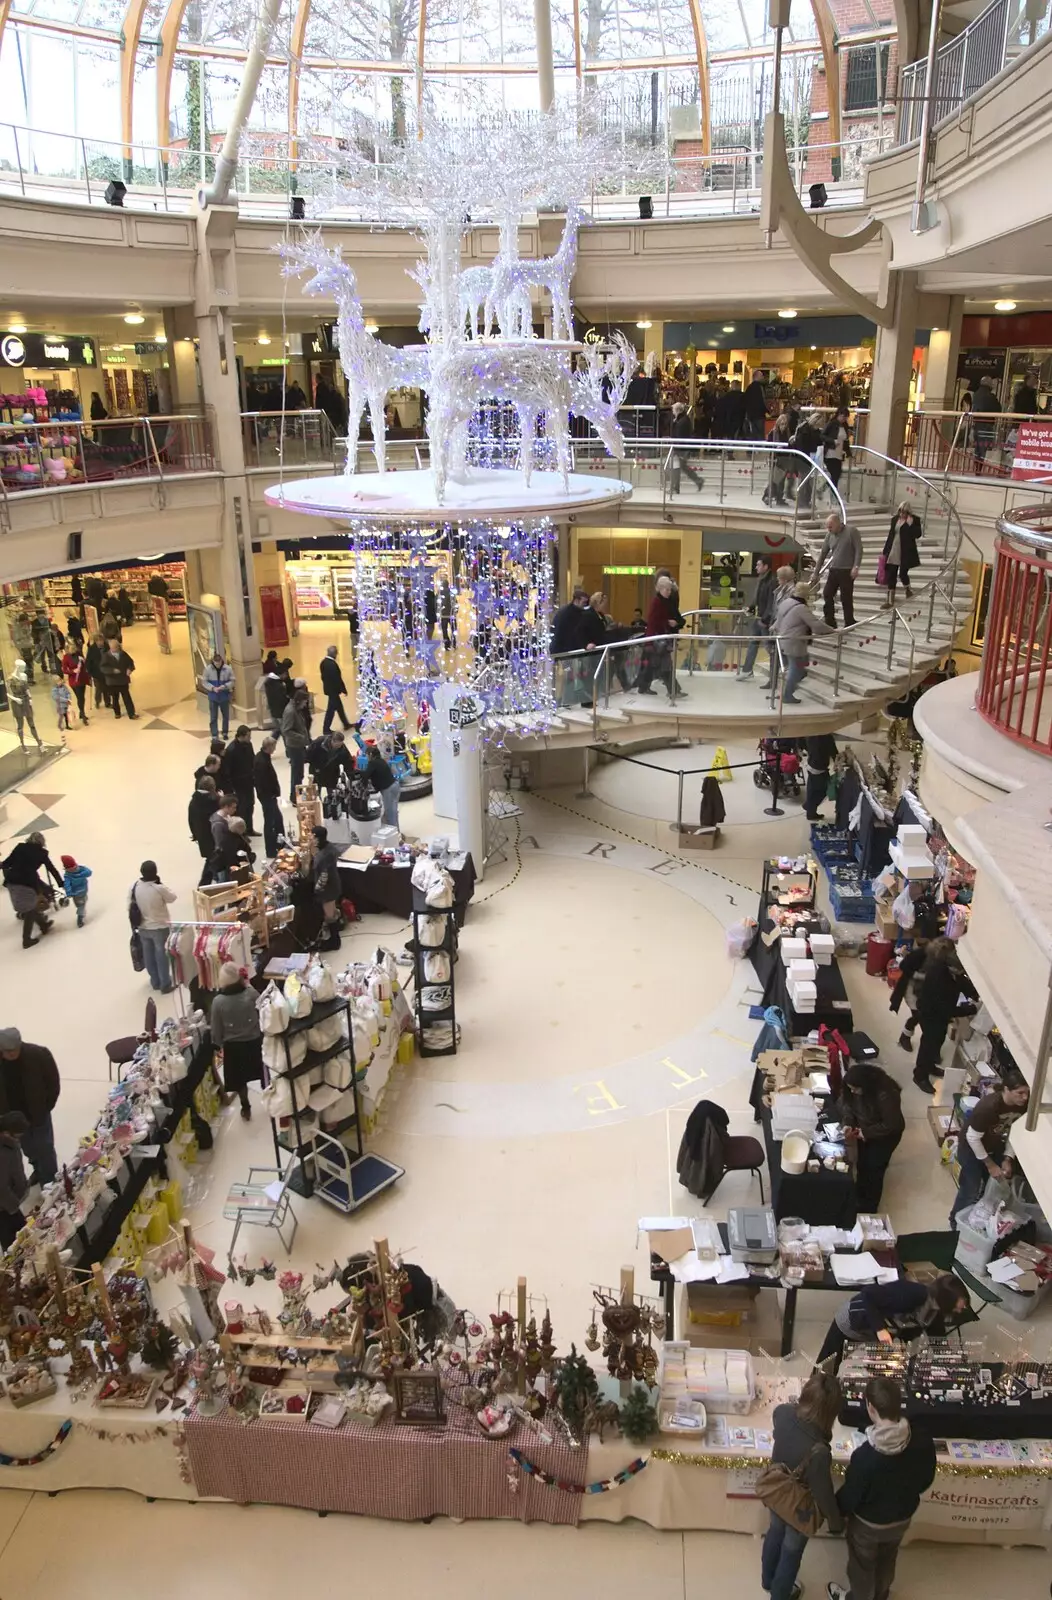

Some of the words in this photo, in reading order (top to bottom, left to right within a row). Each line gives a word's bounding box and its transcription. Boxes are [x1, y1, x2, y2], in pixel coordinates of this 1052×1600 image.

[971, 356, 992, 365] iPhone
[1022, 429, 1038, 437] We've
[1038, 431, 1049, 439] got
[1020, 438, 1040, 447] mobile
[930, 1490, 1039, 1506] Katrinascrafts
[951, 1514, 977, 1523] 07810
